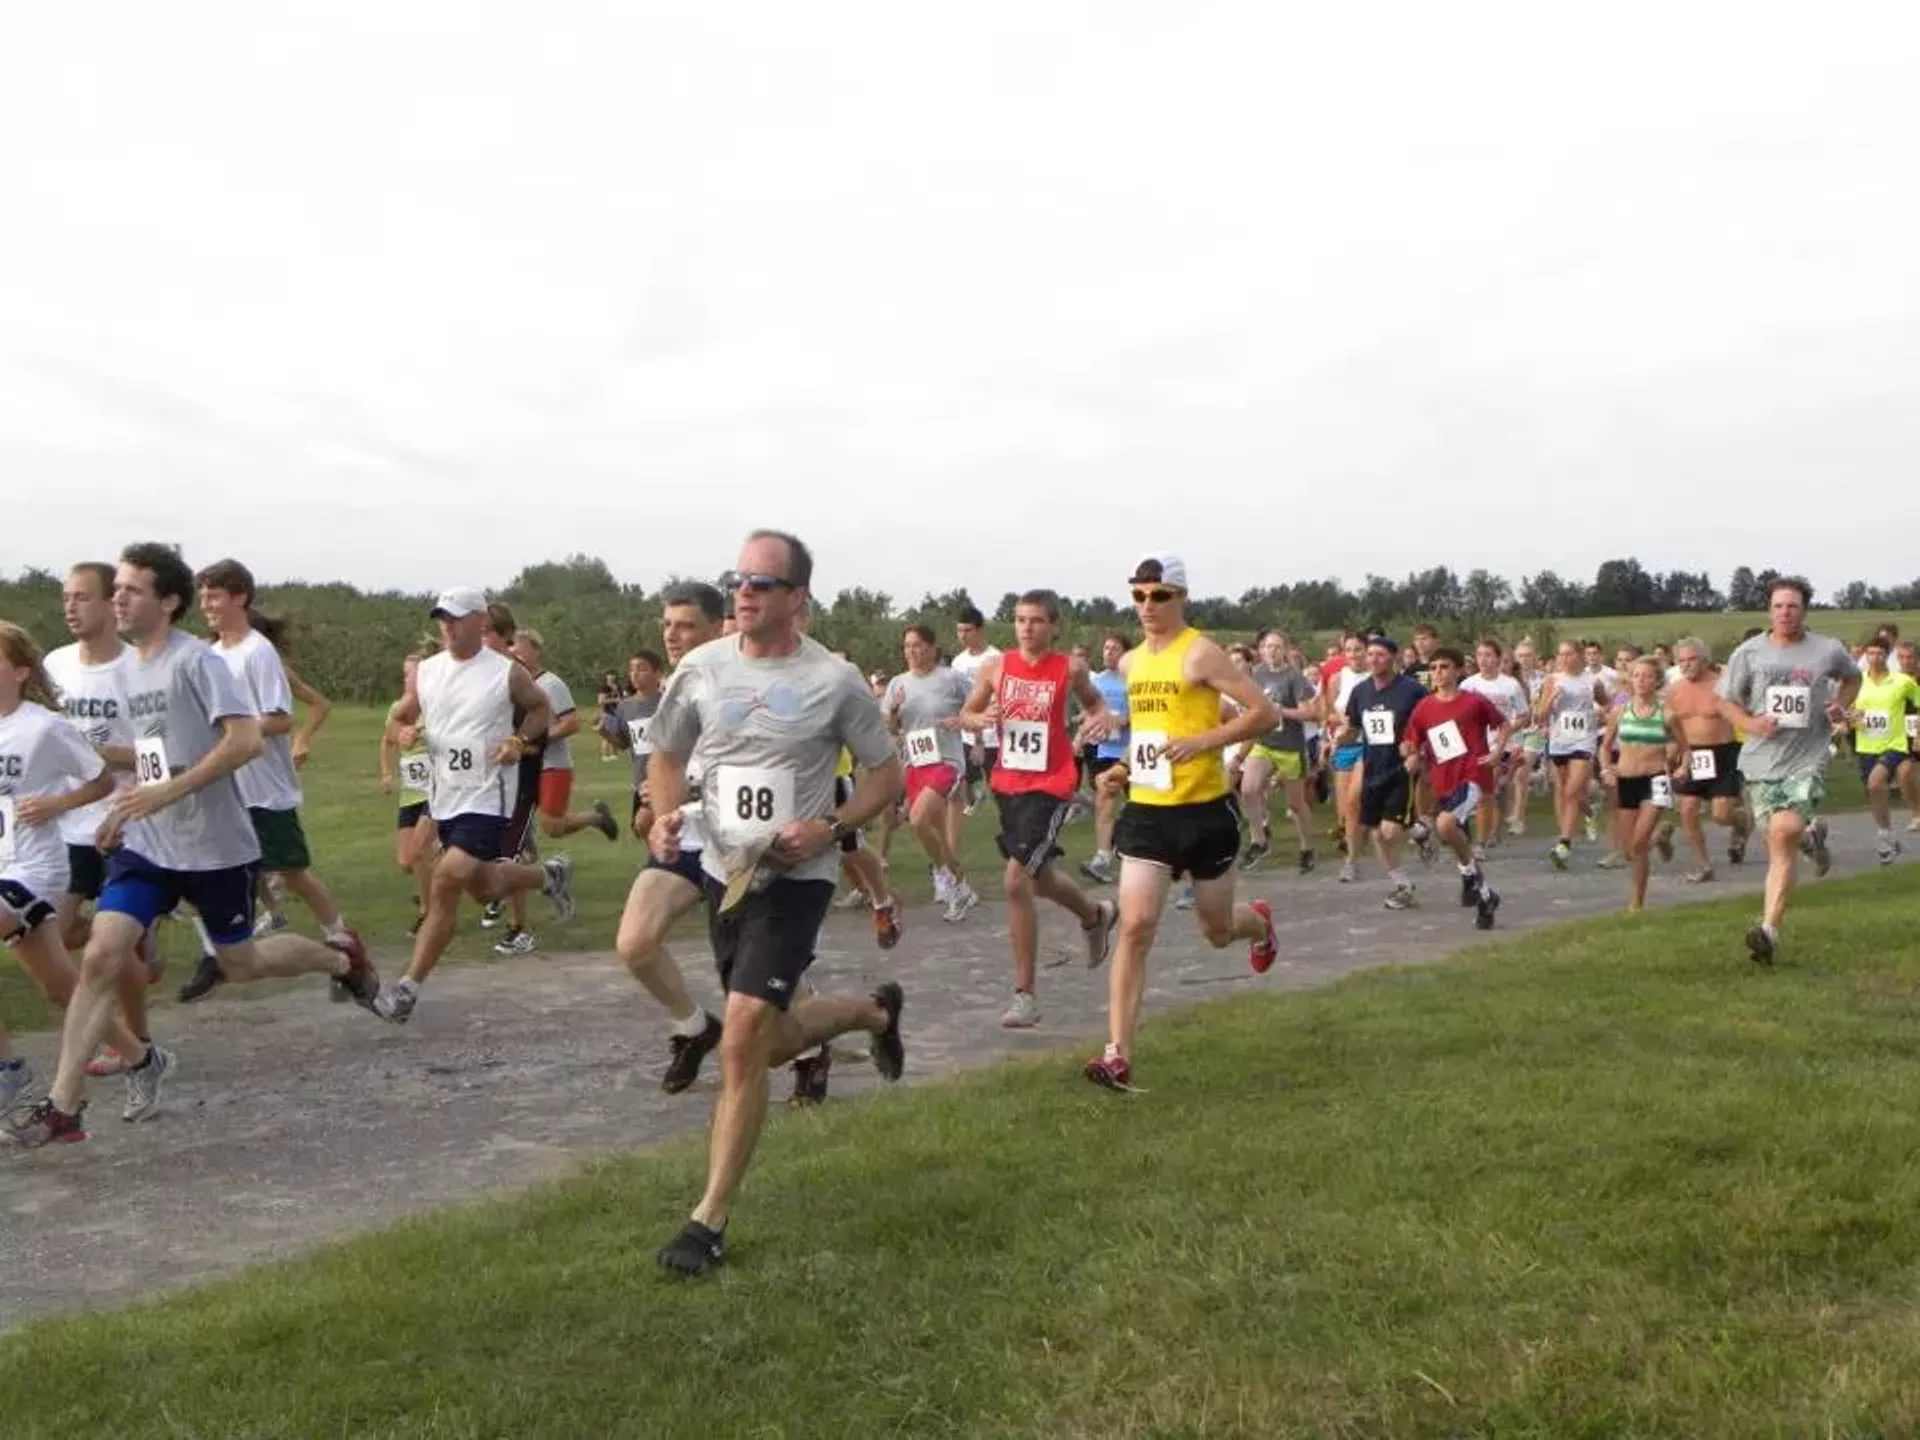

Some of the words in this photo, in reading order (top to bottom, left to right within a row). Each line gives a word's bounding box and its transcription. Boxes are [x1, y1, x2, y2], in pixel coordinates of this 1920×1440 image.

[1772, 694, 1806, 714] 206
[1370, 718, 1386, 734] 33
[1008, 731, 1042, 754] 145
[138, 751, 163, 782] 08
[449, 748, 473, 771] 28
[1136, 744, 1158, 770] 49
[736, 785, 775, 822] 88
